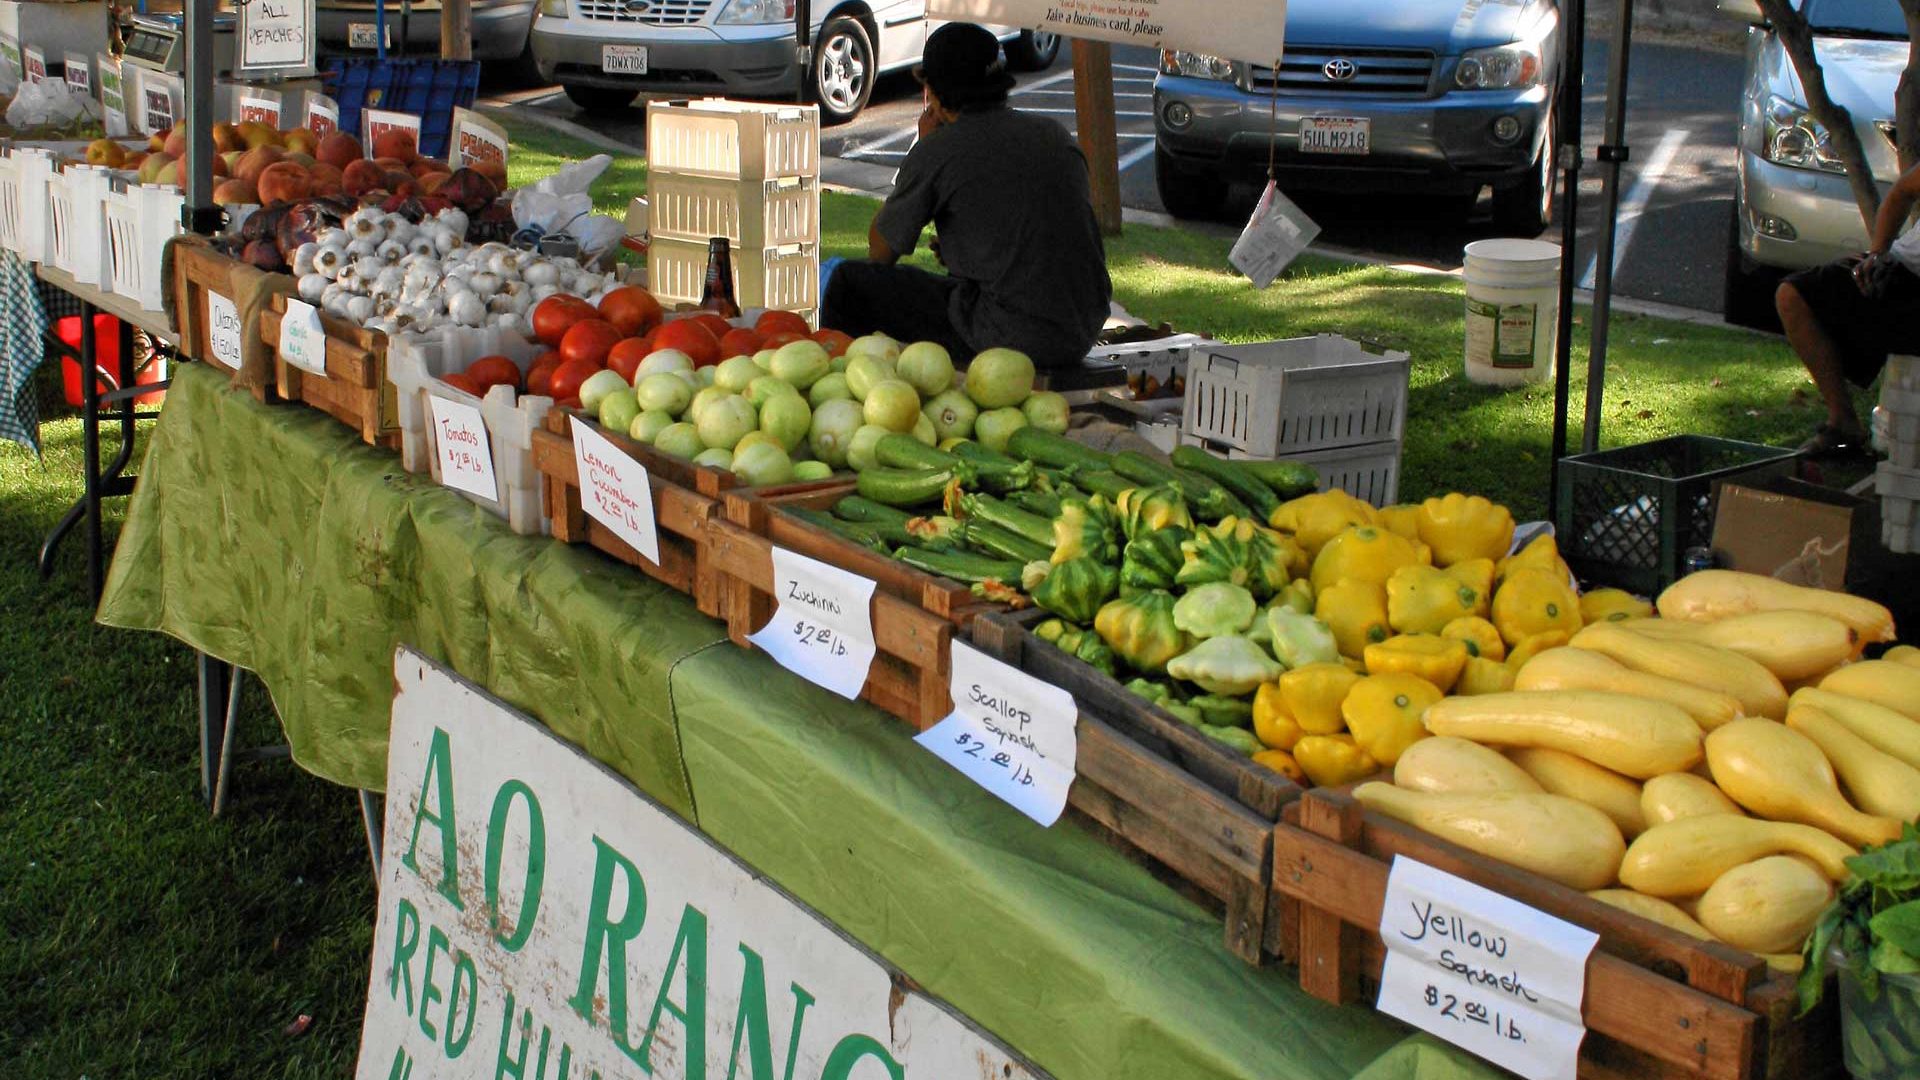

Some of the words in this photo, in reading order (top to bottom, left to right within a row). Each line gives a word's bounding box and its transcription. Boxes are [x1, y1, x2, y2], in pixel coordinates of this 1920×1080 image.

[261, 2, 289, 19] ALL
[1046, 7, 1064, 22] Take
[1065, 14, 1072, 24] a
[1109, 17, 1132, 32] card,
[1132, 19, 1163, 37] please
[249, 26, 304, 45] PEACHES
[606, 54, 644, 70] 7DWX706
[1303, 130, 1366, 149] 5ULM918
[442, 419, 479, 446] Tomatos
[580, 437, 622, 483] Lemon
[391, 897, 478, 1060] RED
[1438, 950, 1539, 1004] Squash
